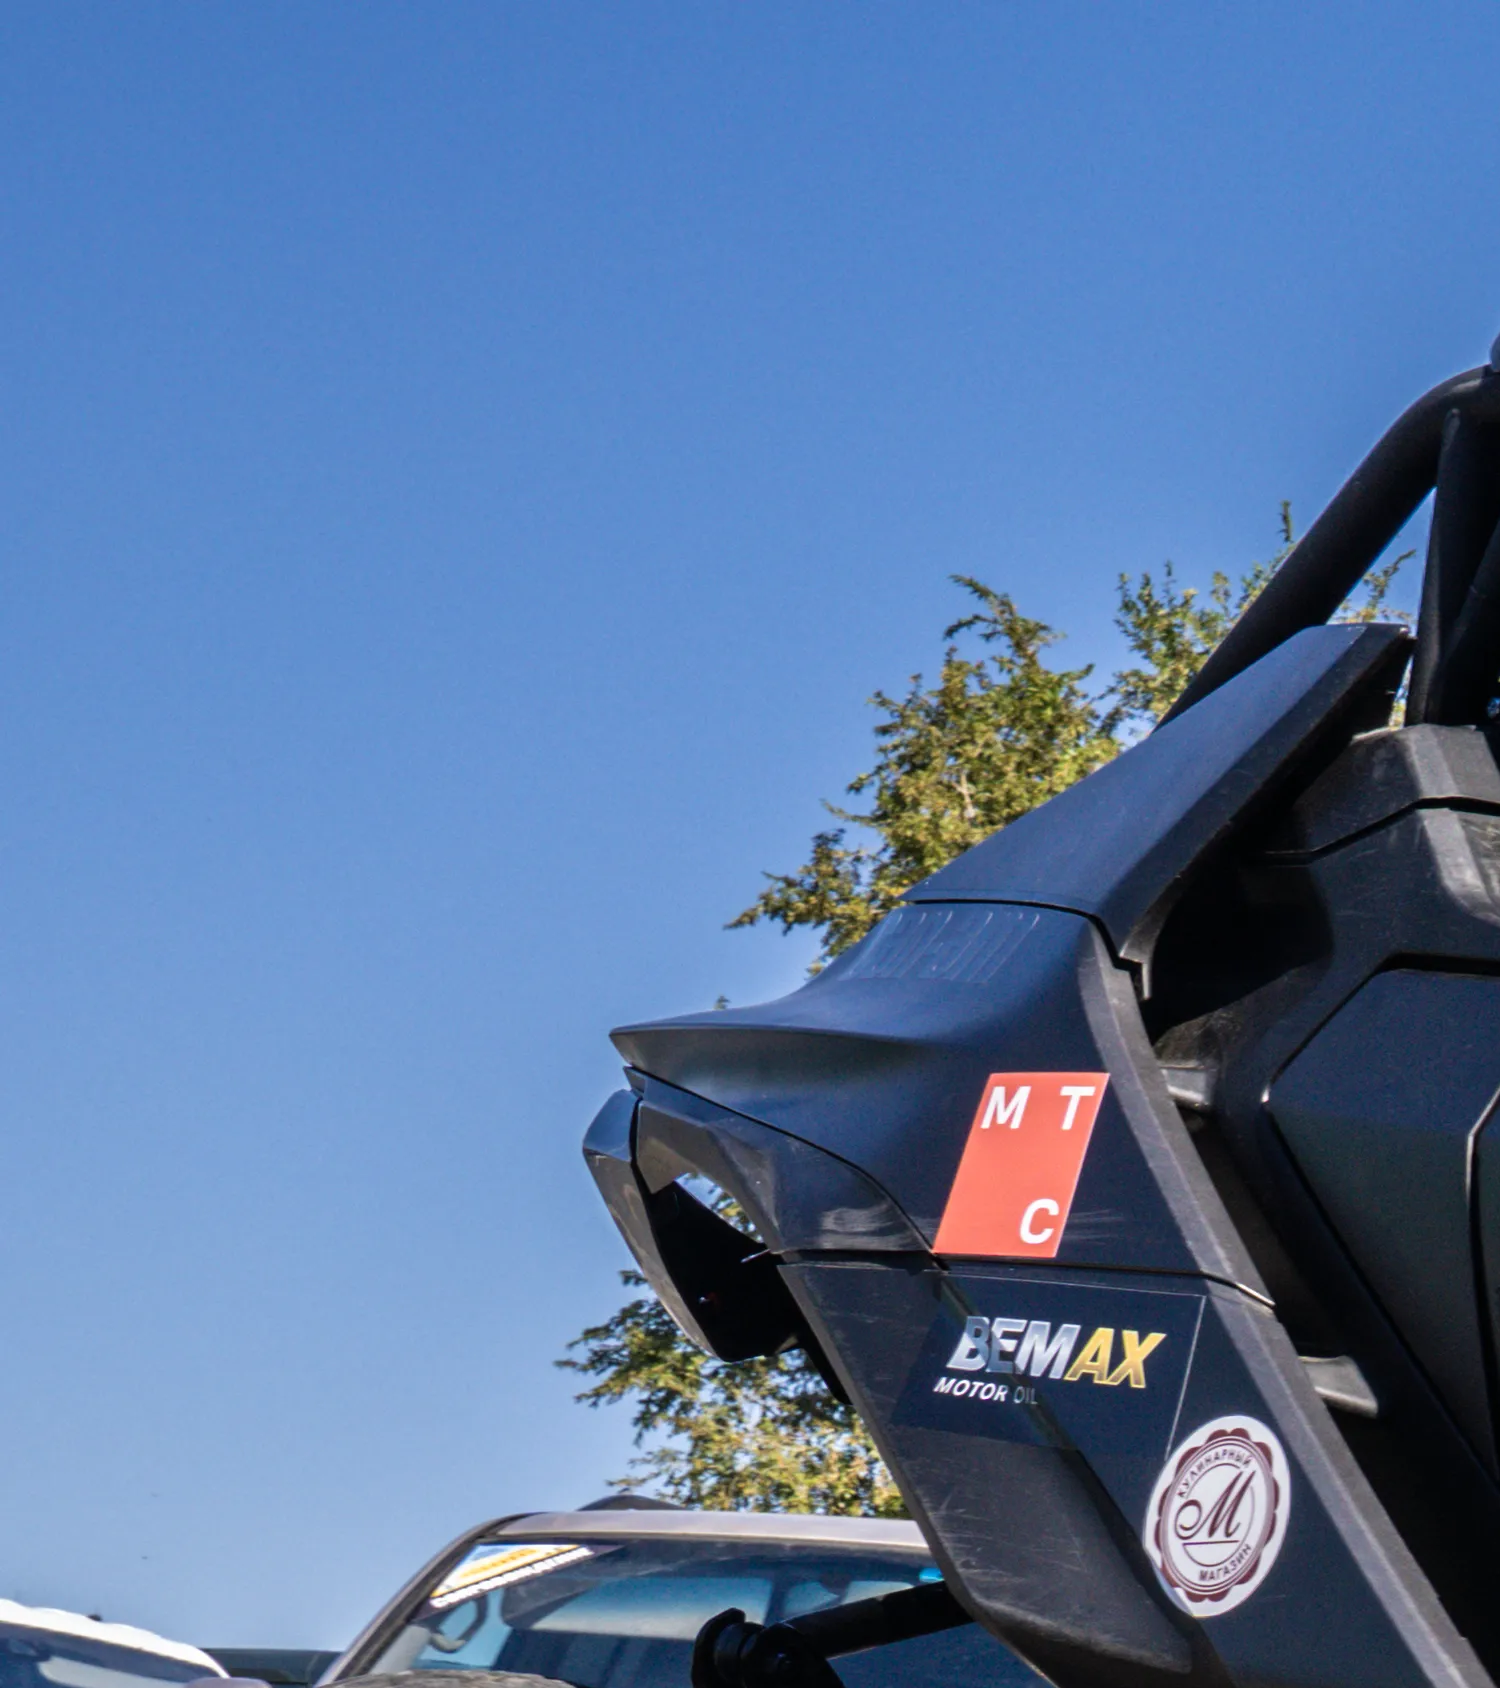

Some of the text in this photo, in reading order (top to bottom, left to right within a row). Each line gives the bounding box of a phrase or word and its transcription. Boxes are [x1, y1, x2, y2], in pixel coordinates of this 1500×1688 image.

[946, 1316, 1167, 1388] BEMAX
[933, 1377, 1038, 1404] MOTOR OIL
[1177, 1448, 1253, 1499] КУЛИНАРНЫЙ
[1199, 1544, 1252, 1581] МАГАЗИН
